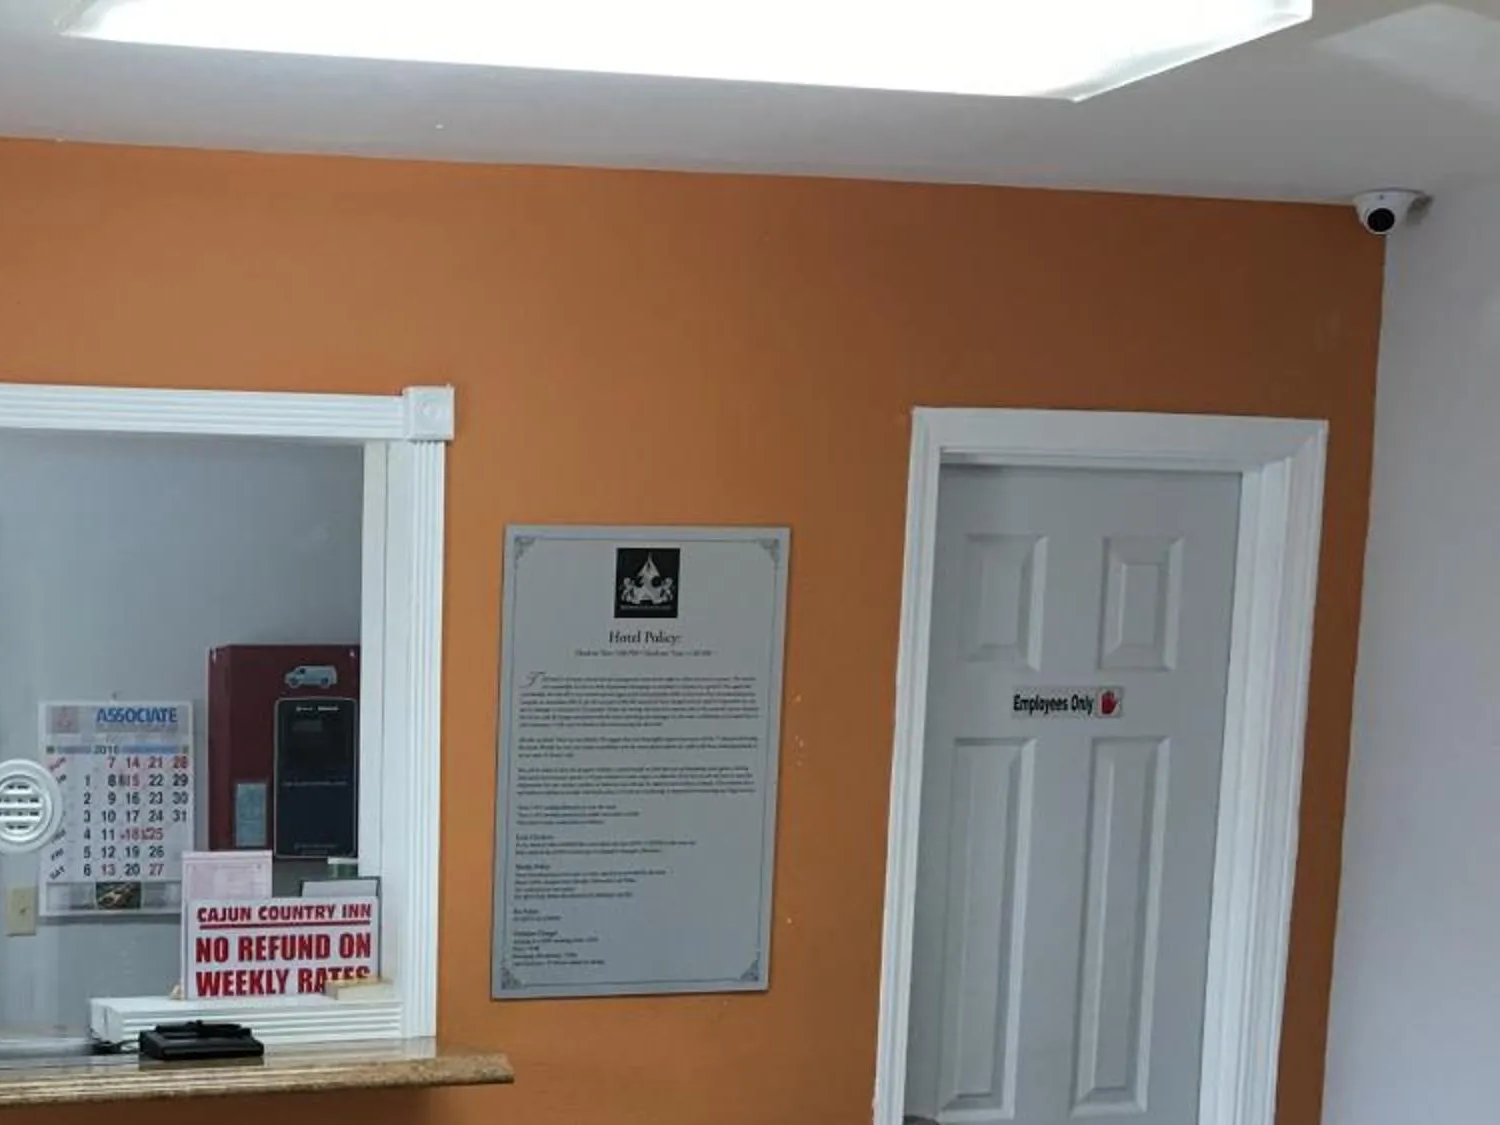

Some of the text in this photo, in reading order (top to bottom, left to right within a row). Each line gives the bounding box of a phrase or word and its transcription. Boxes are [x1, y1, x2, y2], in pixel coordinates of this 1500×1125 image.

[608, 629, 641, 644] Hotel
[1013, 694, 1094, 716] Employees Only
[96, 707, 177, 723] ASSOCIATE
[108, 756, 116, 768] 7
[126, 756, 139, 768] 14
[148, 756, 162, 768] 21
[85, 774, 91, 786] 1
[148, 774, 164, 786] 22
[172, 774, 188, 787] 29
[83, 792, 91, 805] 2
[107, 792, 116, 805] 9
[148, 792, 163, 804] 23
[102, 810, 116, 823] 10
[126, 810, 140, 822] 17
[148, 810, 164, 822] 24
[172, 809, 187, 822] 31
[83, 828, 91, 840] 4
[102, 828, 115, 840] 11
[102, 846, 116, 859] 12
[126, 846, 140, 858] 19
[148, 846, 164, 858] 26
[83, 864, 91, 876] 6
[102, 864, 116, 876] 13
[125, 864, 140, 876] 20
[148, 864, 164, 876] 27
[197, 903, 371, 922] CAJUN COUNTRY INN
[196, 932, 371, 963] NO REFUND ON
[196, 968, 289, 997] WEEKLY
